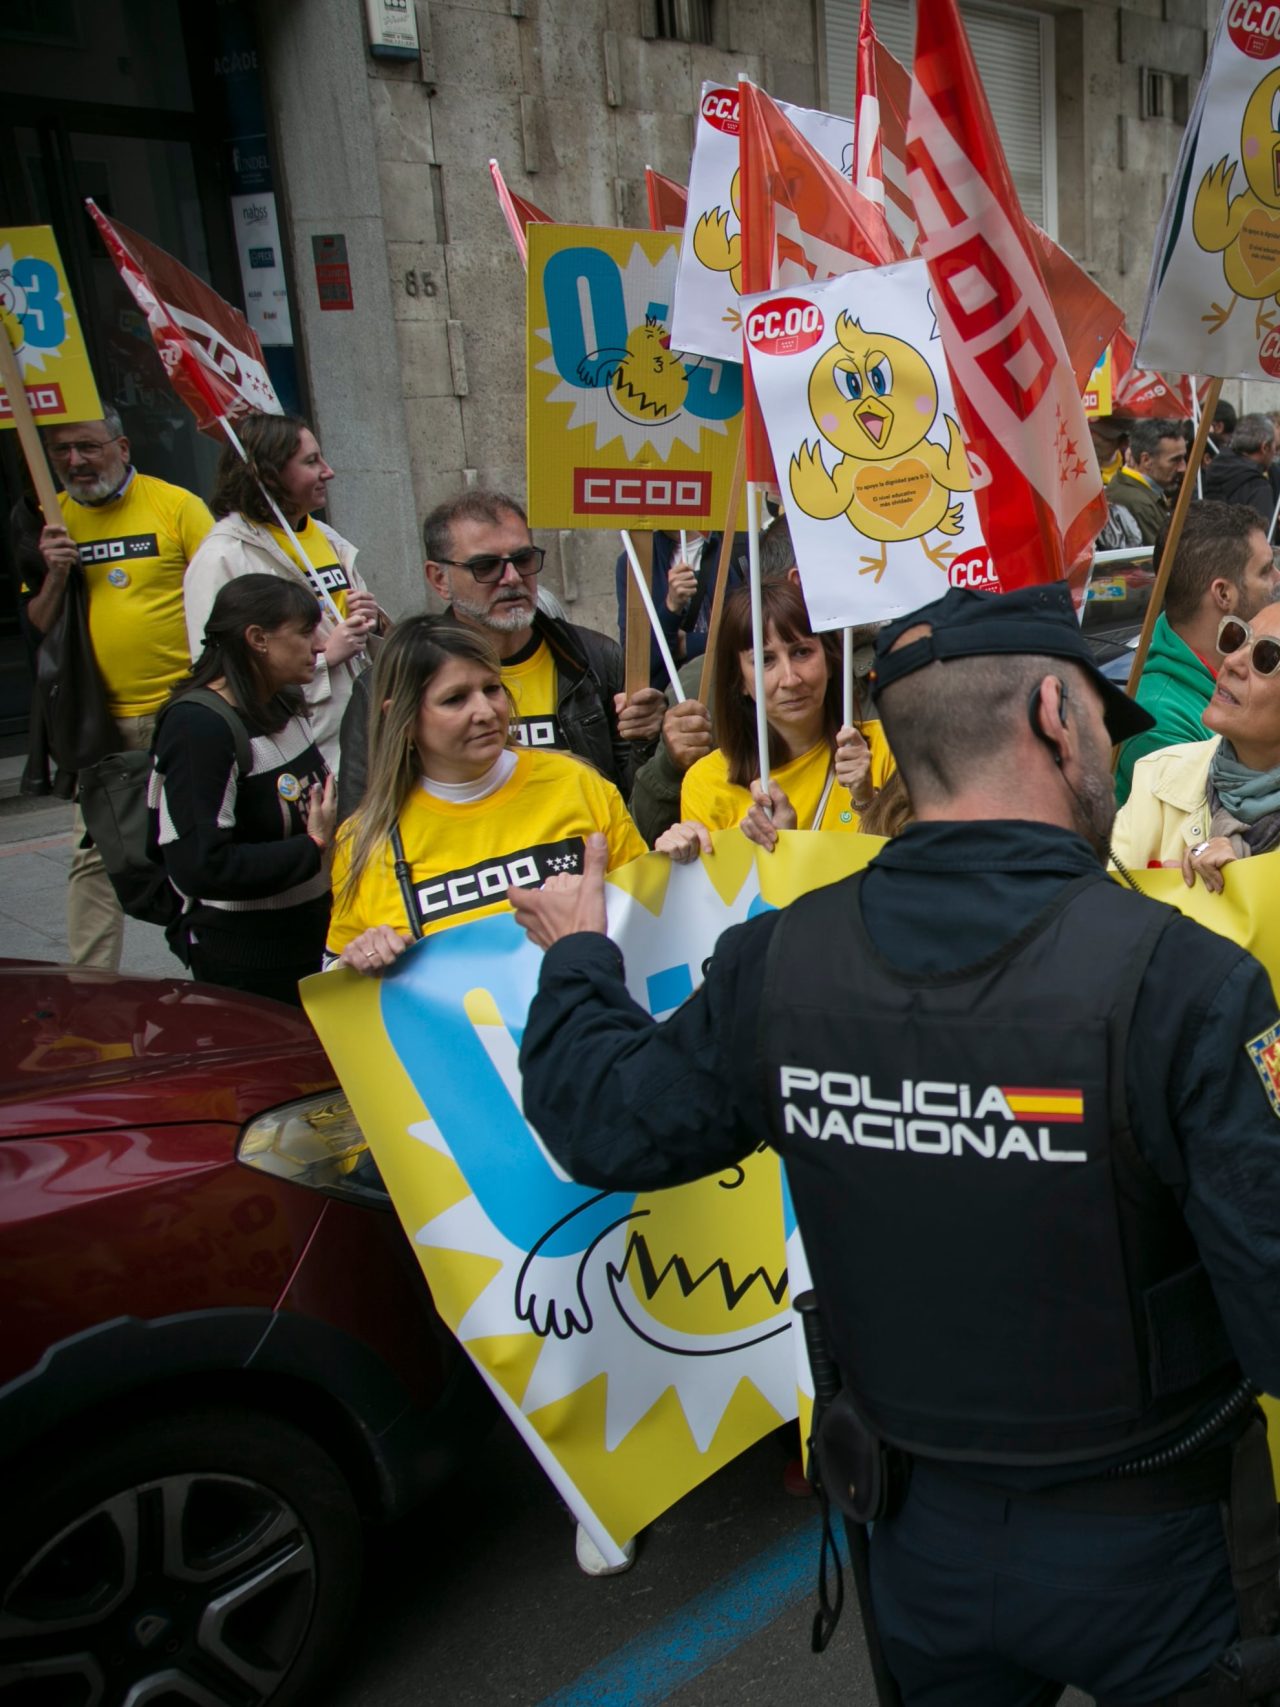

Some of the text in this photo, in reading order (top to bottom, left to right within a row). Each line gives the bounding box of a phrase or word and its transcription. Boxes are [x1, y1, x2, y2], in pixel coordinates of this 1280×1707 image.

[748, 305, 823, 342] CC.OO.
[584, 478, 702, 506] CCOO
[79, 541, 126, 562] COO
[417, 855, 541, 915] CCOO
[783, 1102, 1088, 1162] NACIONAL
